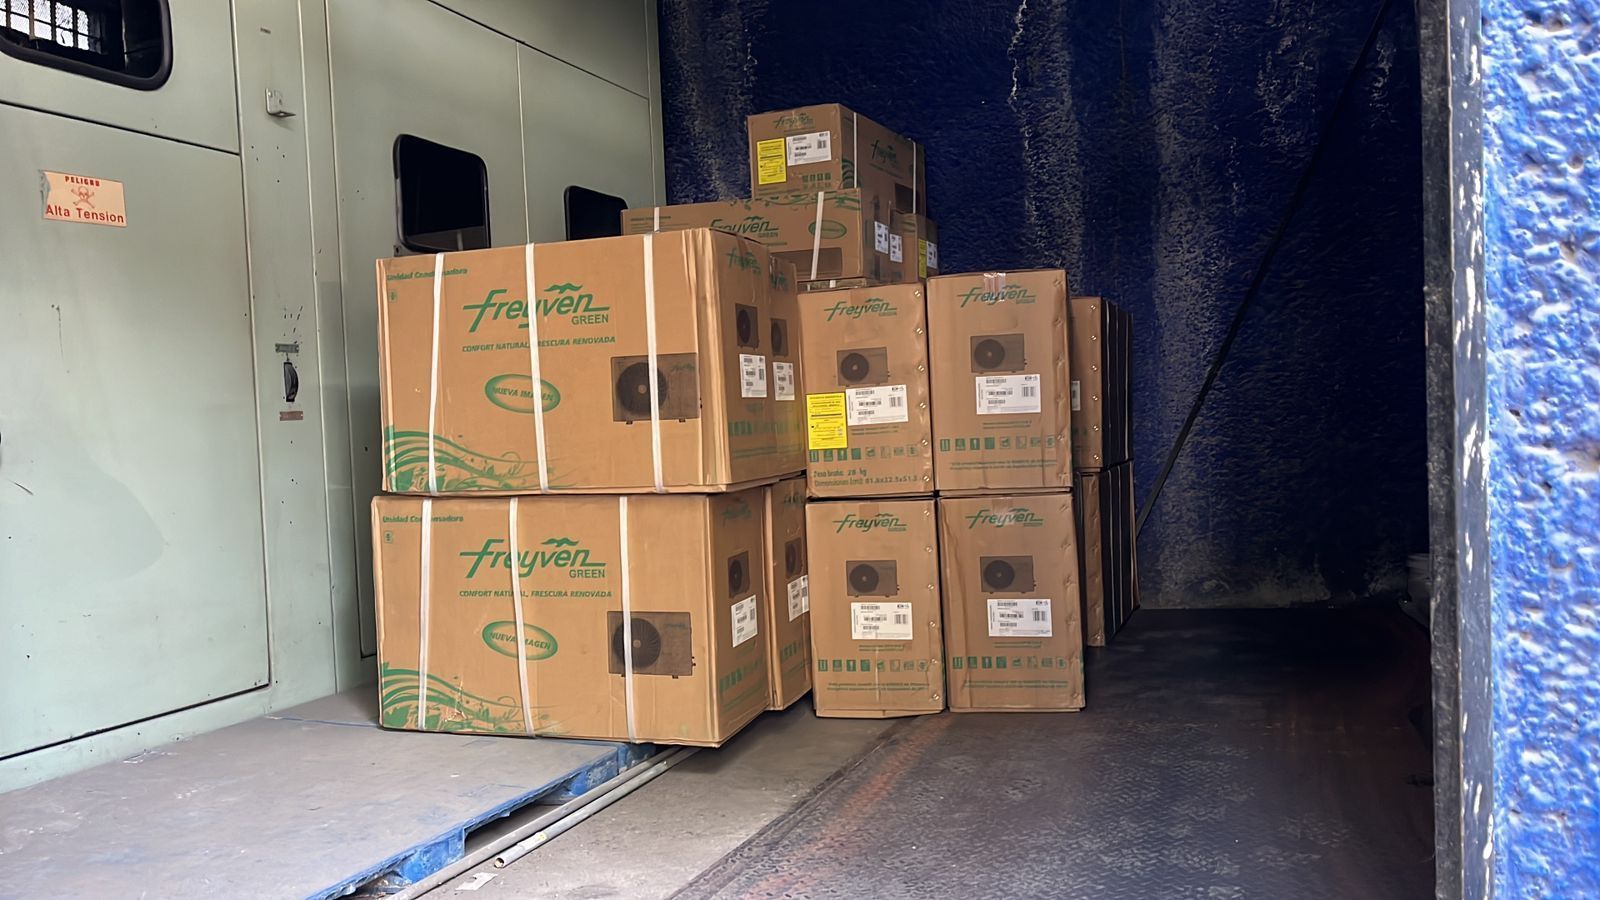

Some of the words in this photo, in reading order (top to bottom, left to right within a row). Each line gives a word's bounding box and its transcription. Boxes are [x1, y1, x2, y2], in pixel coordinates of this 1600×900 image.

[65, 176, 100, 186] PELIGRO
[46, 204, 70, 217] Alta
[76, 208, 124, 223] Tension
[571, 313, 609, 326] GREEN
[462, 344, 494, 353] CONFORT
[537, 339, 571, 348] RESCURA
[572, 336, 615, 346] RENOVADA
[569, 569, 605, 578] GREEN
[459, 590, 492, 598] CONFORT
[531, 590, 567, 598] FRESCURA
[571, 590, 612, 598] RENOVADA
